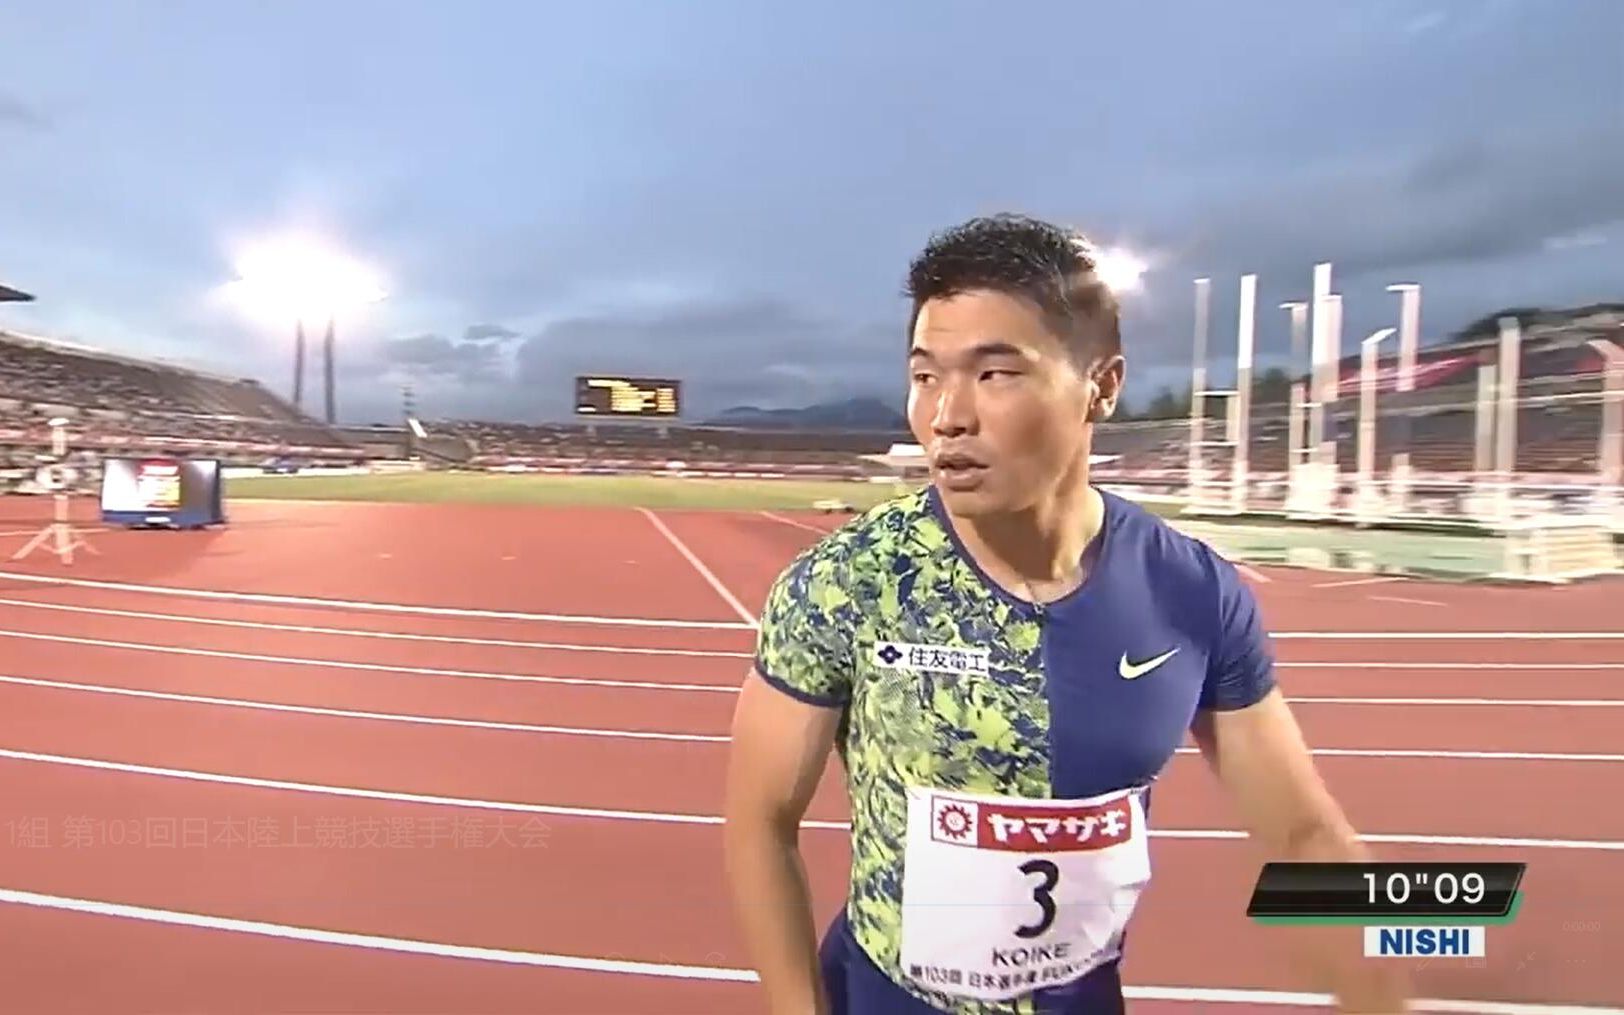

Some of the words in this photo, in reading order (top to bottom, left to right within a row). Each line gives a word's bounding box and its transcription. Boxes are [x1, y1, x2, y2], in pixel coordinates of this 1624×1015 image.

[908, 647, 986, 672] 住友電工
[1013, 859, 1060, 939] 3
[992, 942, 1072, 967] KOIKE
